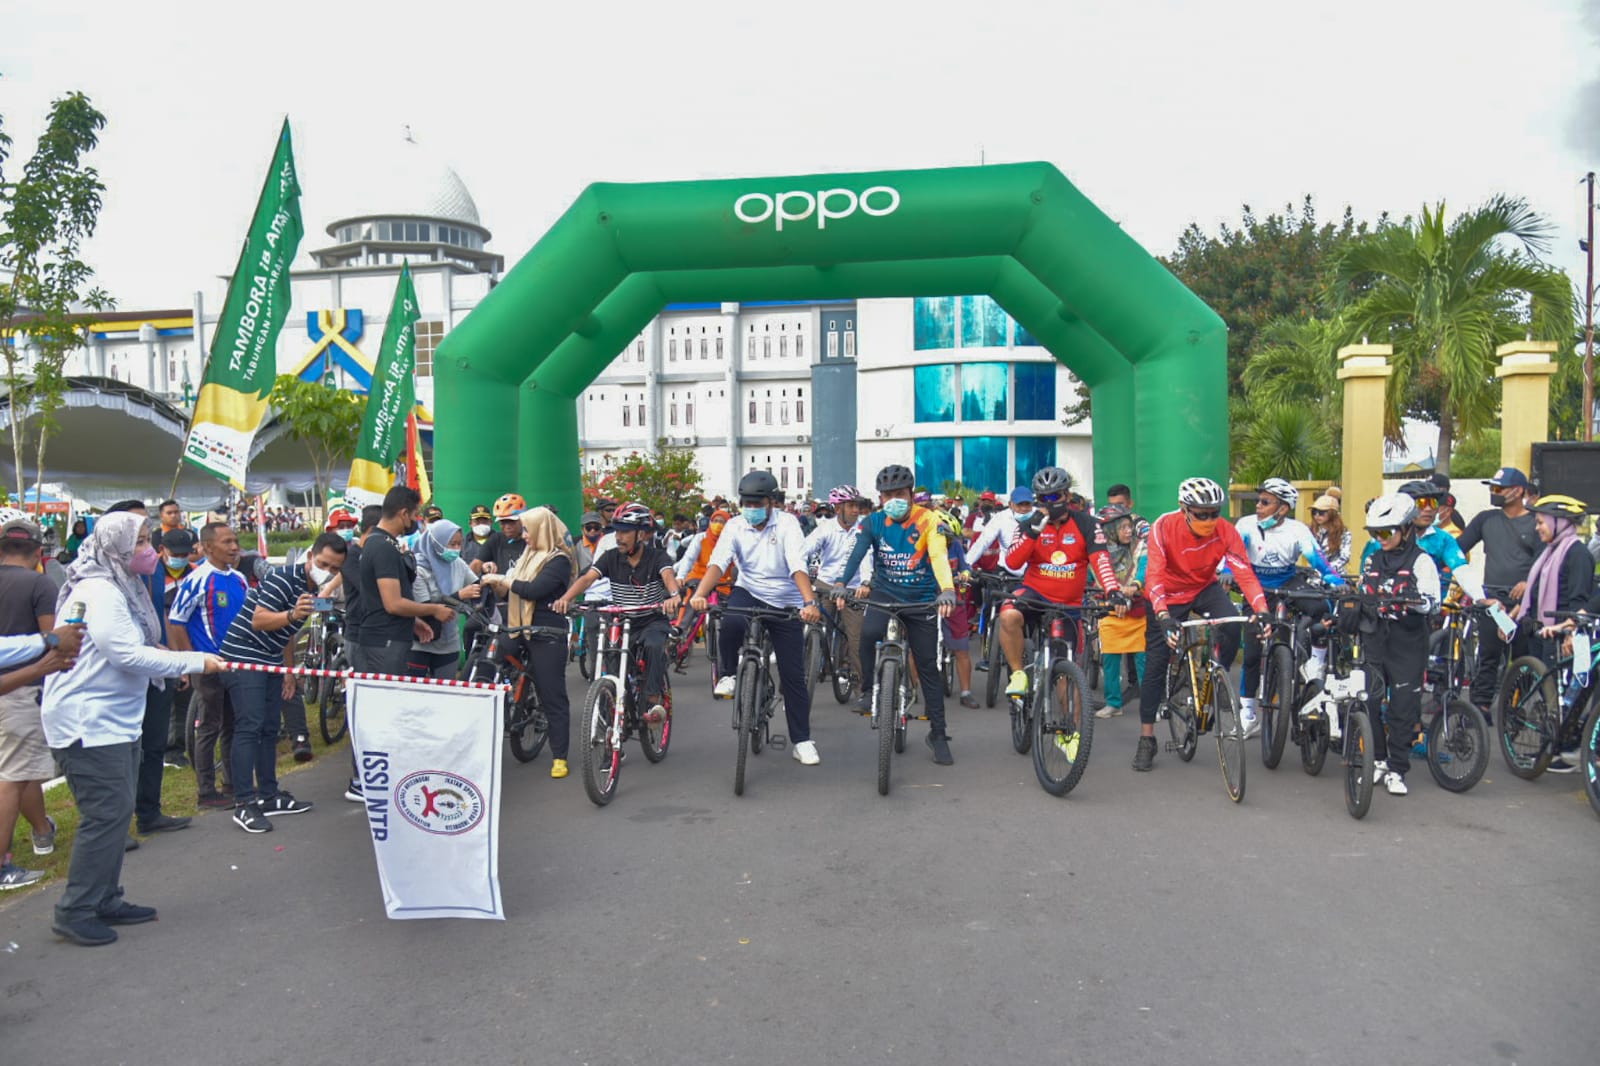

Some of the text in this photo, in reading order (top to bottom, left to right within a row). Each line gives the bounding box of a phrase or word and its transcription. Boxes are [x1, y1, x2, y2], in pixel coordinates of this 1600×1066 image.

[734, 185, 900, 231] oppo
[229, 275, 267, 371] TAMBORA
[242, 320, 271, 381] TABUNGAN
[363, 751, 388, 791] ISSI
